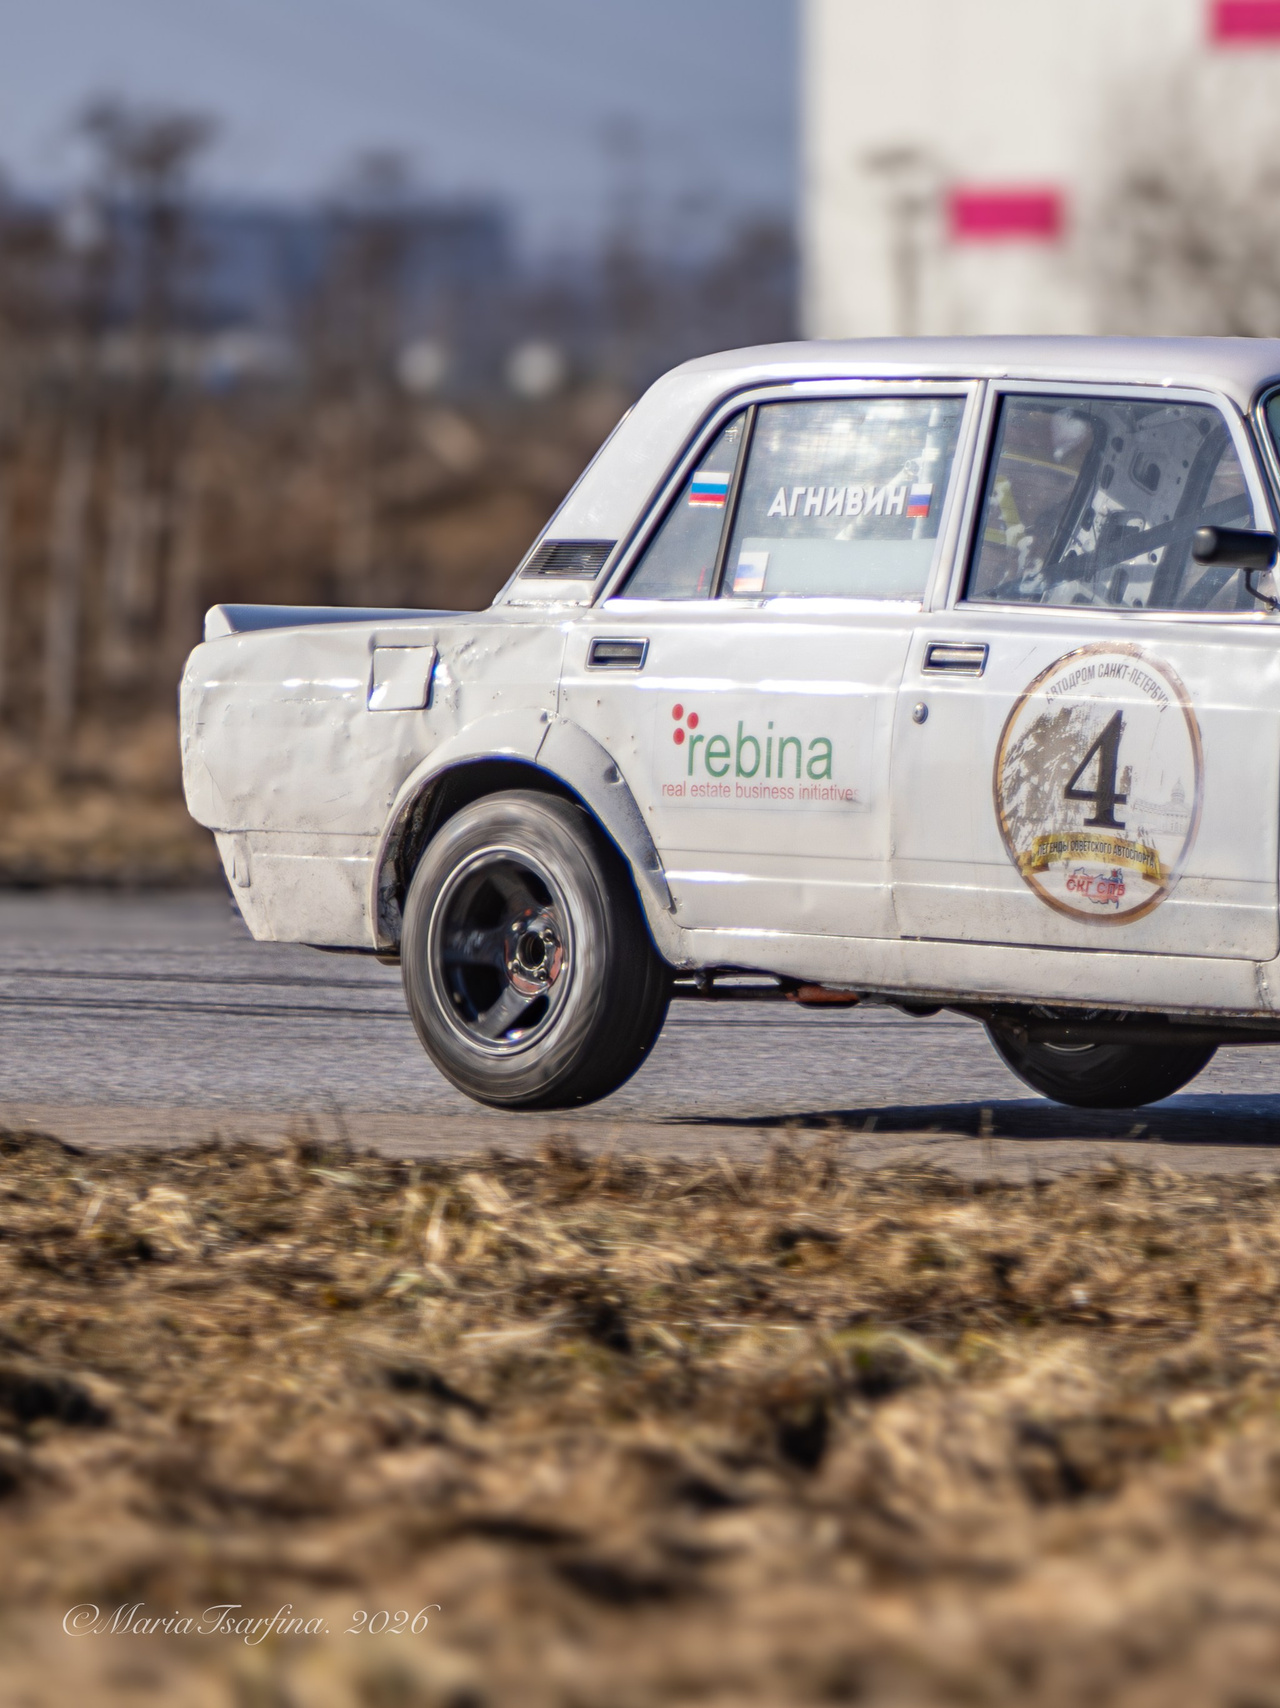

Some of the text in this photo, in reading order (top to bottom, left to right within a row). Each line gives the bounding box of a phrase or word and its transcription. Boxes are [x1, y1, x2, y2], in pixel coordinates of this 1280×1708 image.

[767, 486, 908, 517] АГНИВИН
[1045, 665, 1096, 704] АВТОДРОМ
[687, 720, 833, 780] rebina
[1064, 709, 1127, 830] 4
[662, 781, 686, 798] real
[690, 782, 731, 798] estate
[735, 782, 795, 800] business
